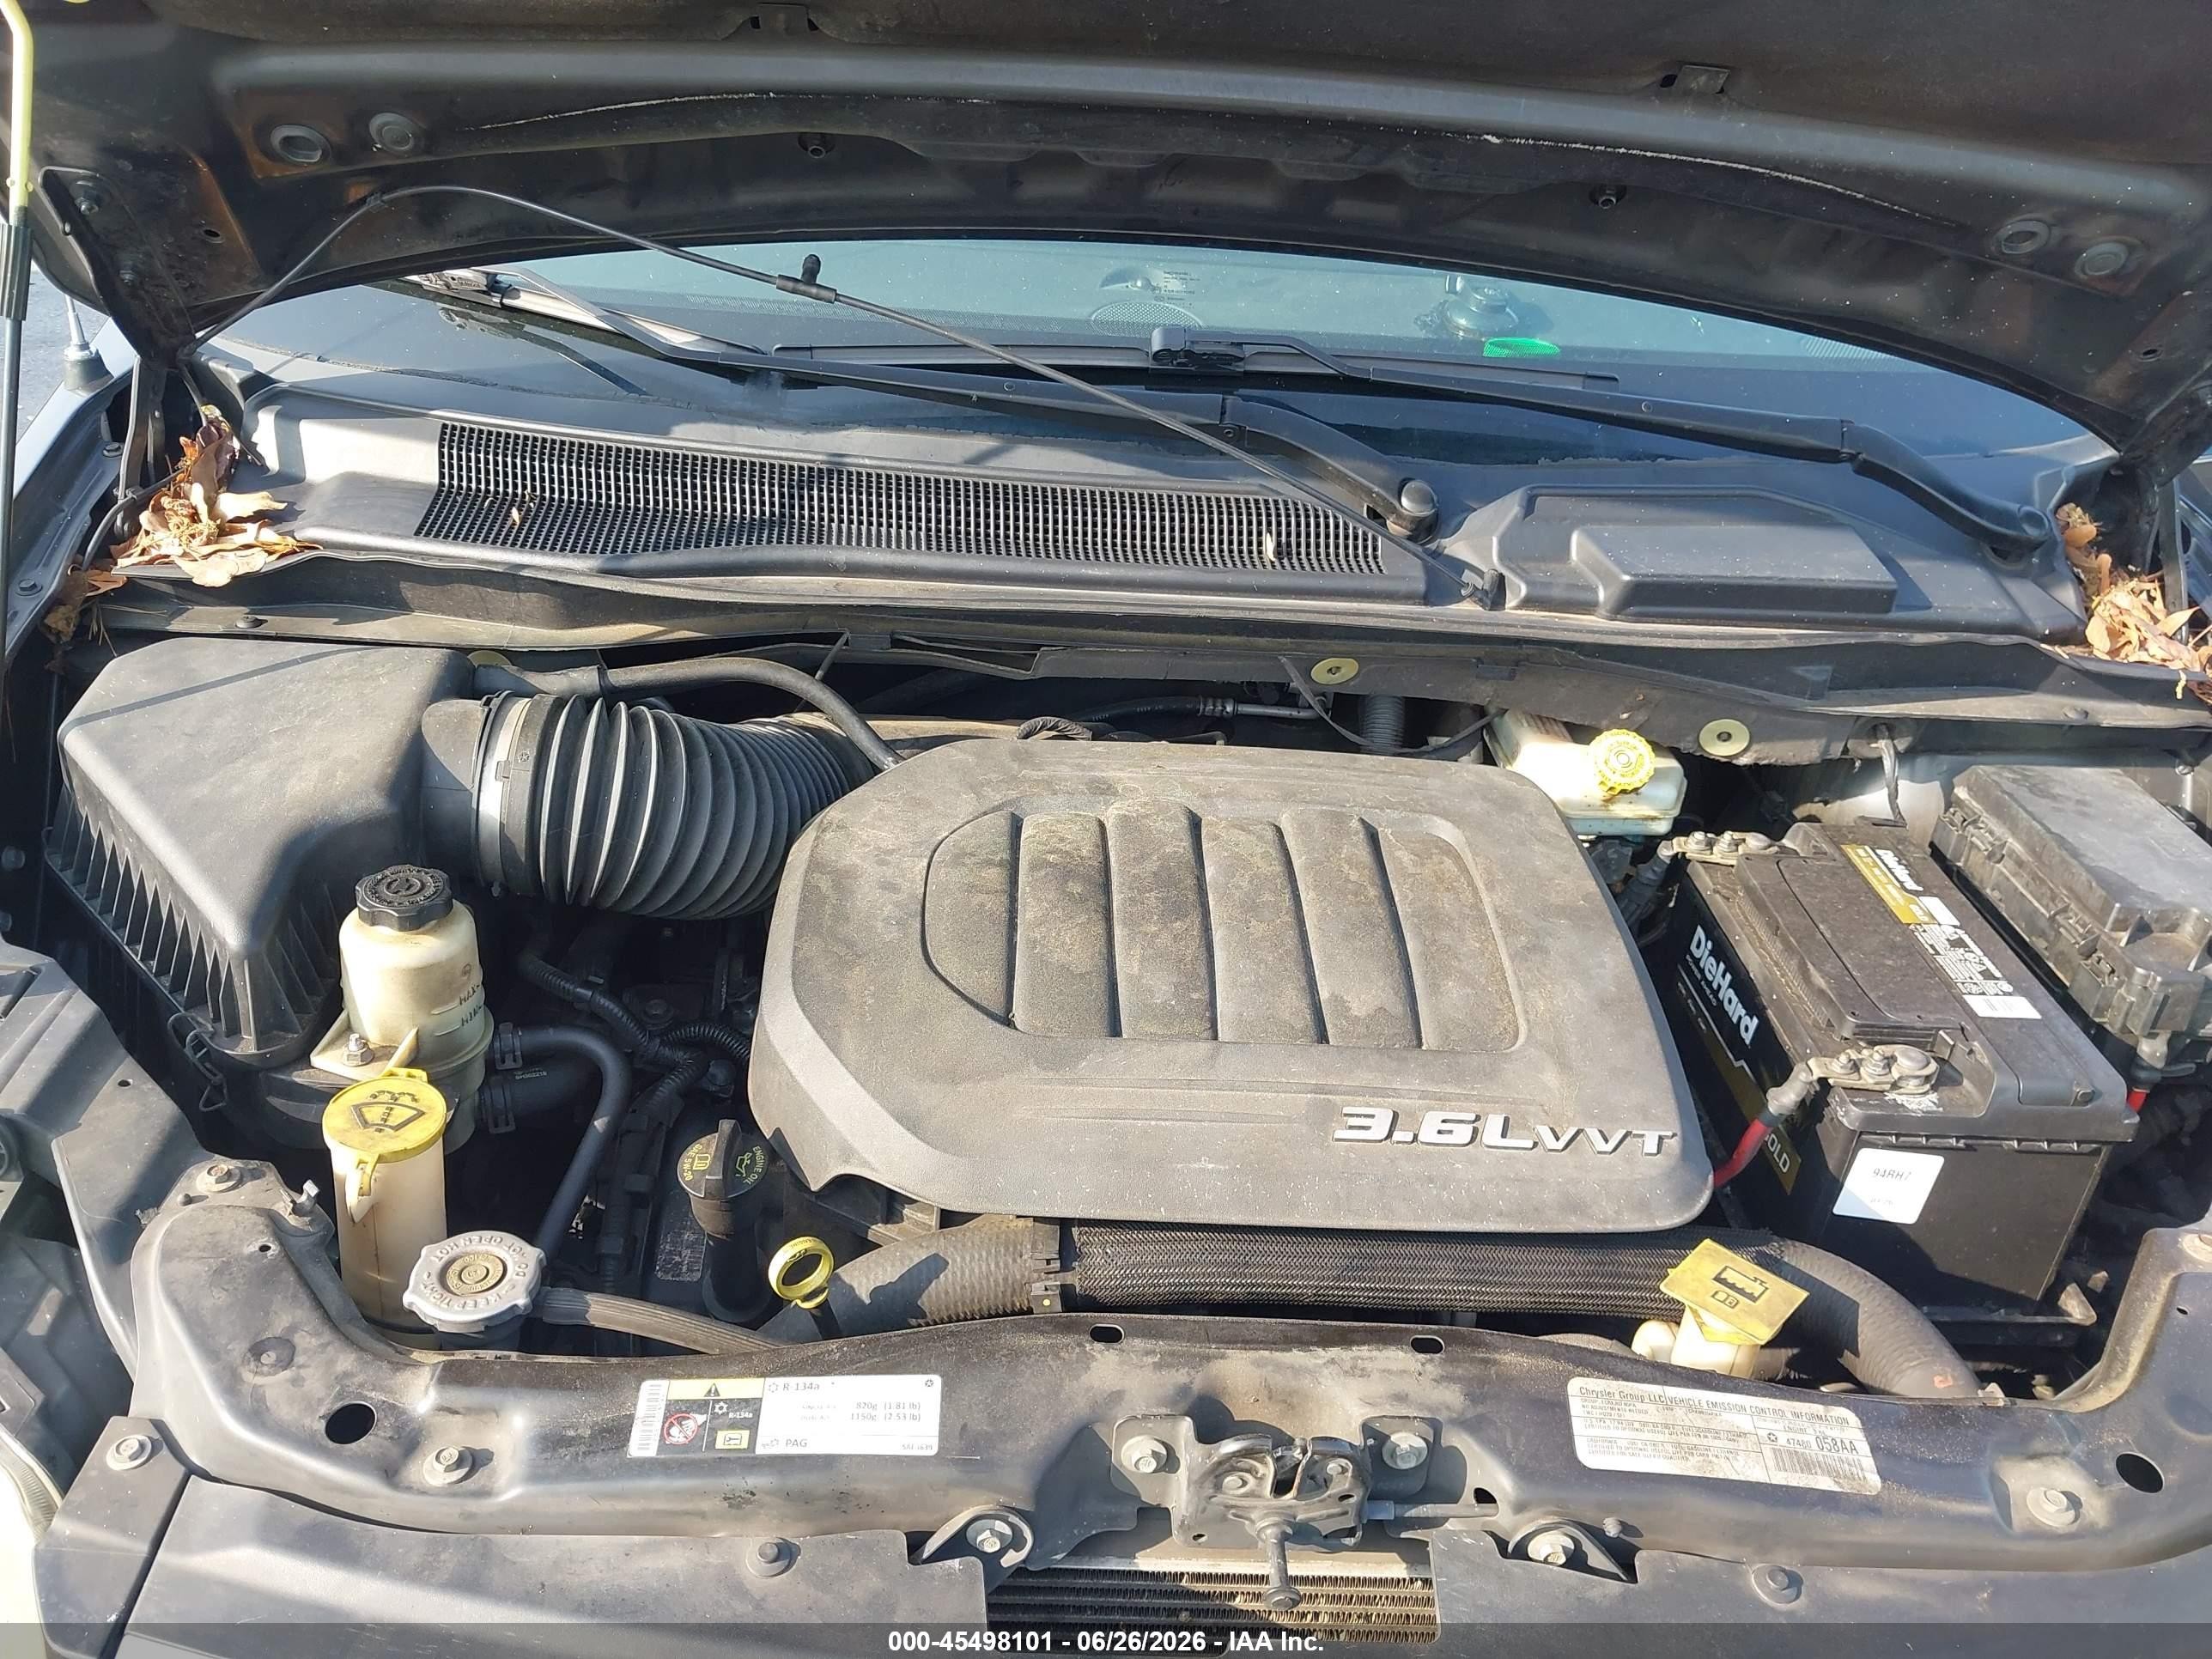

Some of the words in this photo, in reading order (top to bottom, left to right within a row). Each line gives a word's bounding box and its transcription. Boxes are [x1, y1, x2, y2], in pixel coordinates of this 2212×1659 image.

[1690, 924, 1759, 1046] DieHard
[687, 1143, 702, 1158] SAE
[1765, 1131, 1791, 1175] OLD
[752, 1146, 767, 1174] ENGINE
[682, 1158, 694, 1182] 5W-20
[742, 1173, 759, 1186] OIL
[460, 1235, 504, 1247] OPEN
[432, 1242, 459, 1263] HOT
[456, 1292, 502, 1310] KEEP
[1580, 1386, 1615, 1399] Chrysler
[1619, 1390, 1645, 1403] Group
[1648, 1394, 1664, 1403] LLC
[856, 1401, 878, 1412] 820g
[908, 1401, 921, 1411] lb)
[1668, 1395, 1704, 1408] VEHICLE
[1705, 1400, 1747, 1413] EMISSION
[1750, 1405, 1788, 1418] CONTROL
[1790, 1410, 1850, 1426] INFORMATION
[884, 1412, 907, 1422] (2.53
[908, 1412, 921, 1422] lb)
[785, 1437, 808, 1449] PAG
[1815, 1435, 1859, 1455] 058AA
